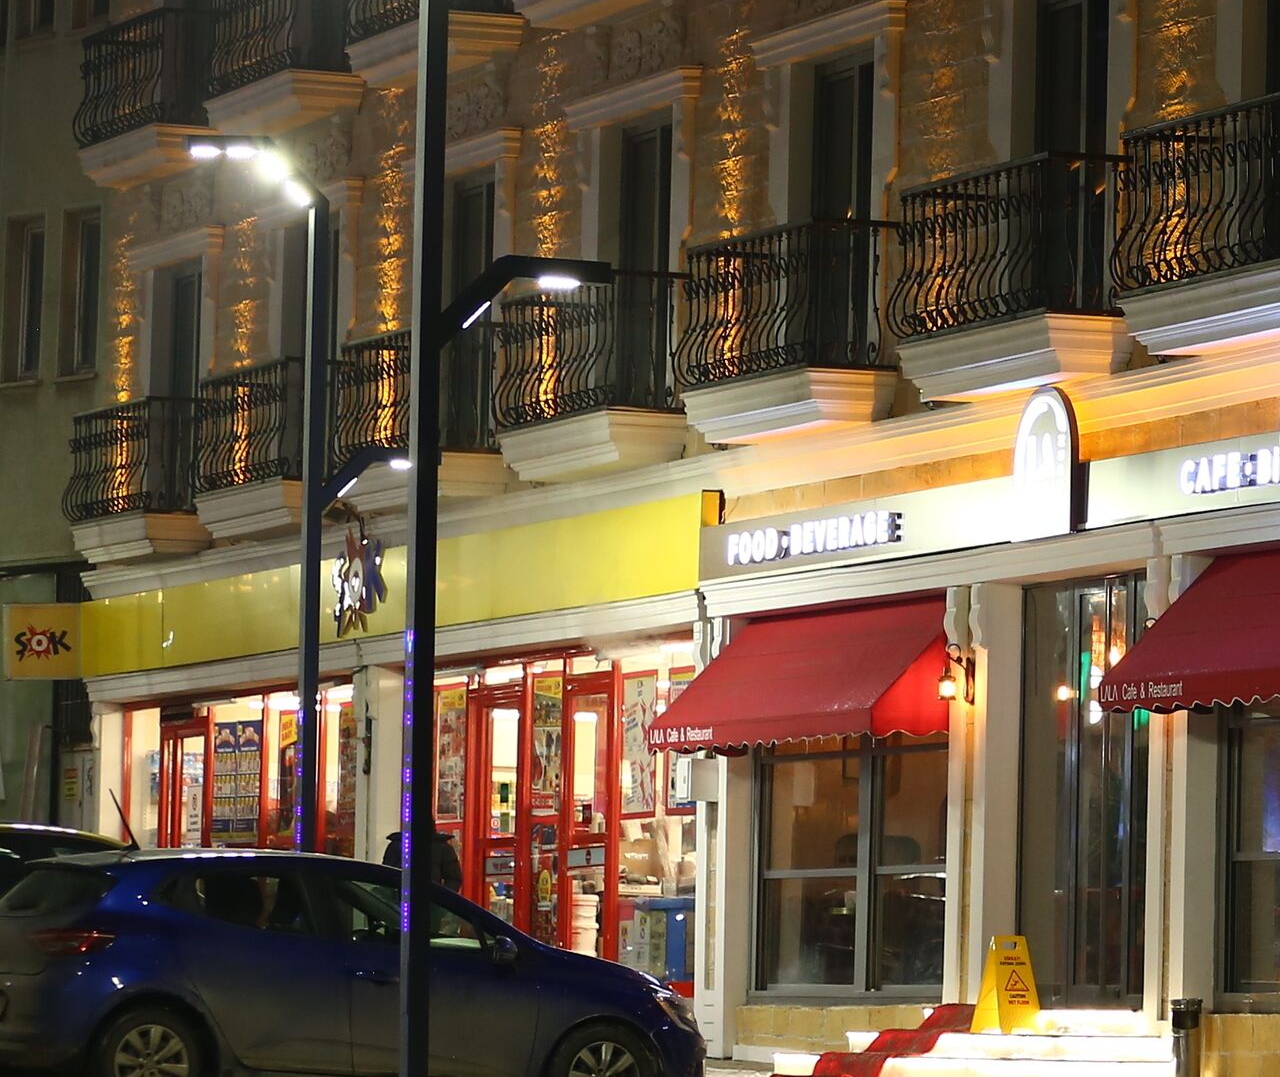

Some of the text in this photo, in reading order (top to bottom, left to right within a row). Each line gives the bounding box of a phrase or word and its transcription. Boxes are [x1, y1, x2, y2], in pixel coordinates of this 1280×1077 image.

[1180, 451, 1242, 496] CAFE
[727, 510, 891, 566] FOOD BEVERAGE
[15, 629, 72, 662] ŞOK
[1122, 682, 1137, 700] Cafe
[1140, 682, 1145, 699] &
[1148, 680, 1183, 698] Restaurant
[666, 727, 679, 743] Cafe
[680, 726, 685, 742] &
[686, 726, 713, 742] Restaurant
